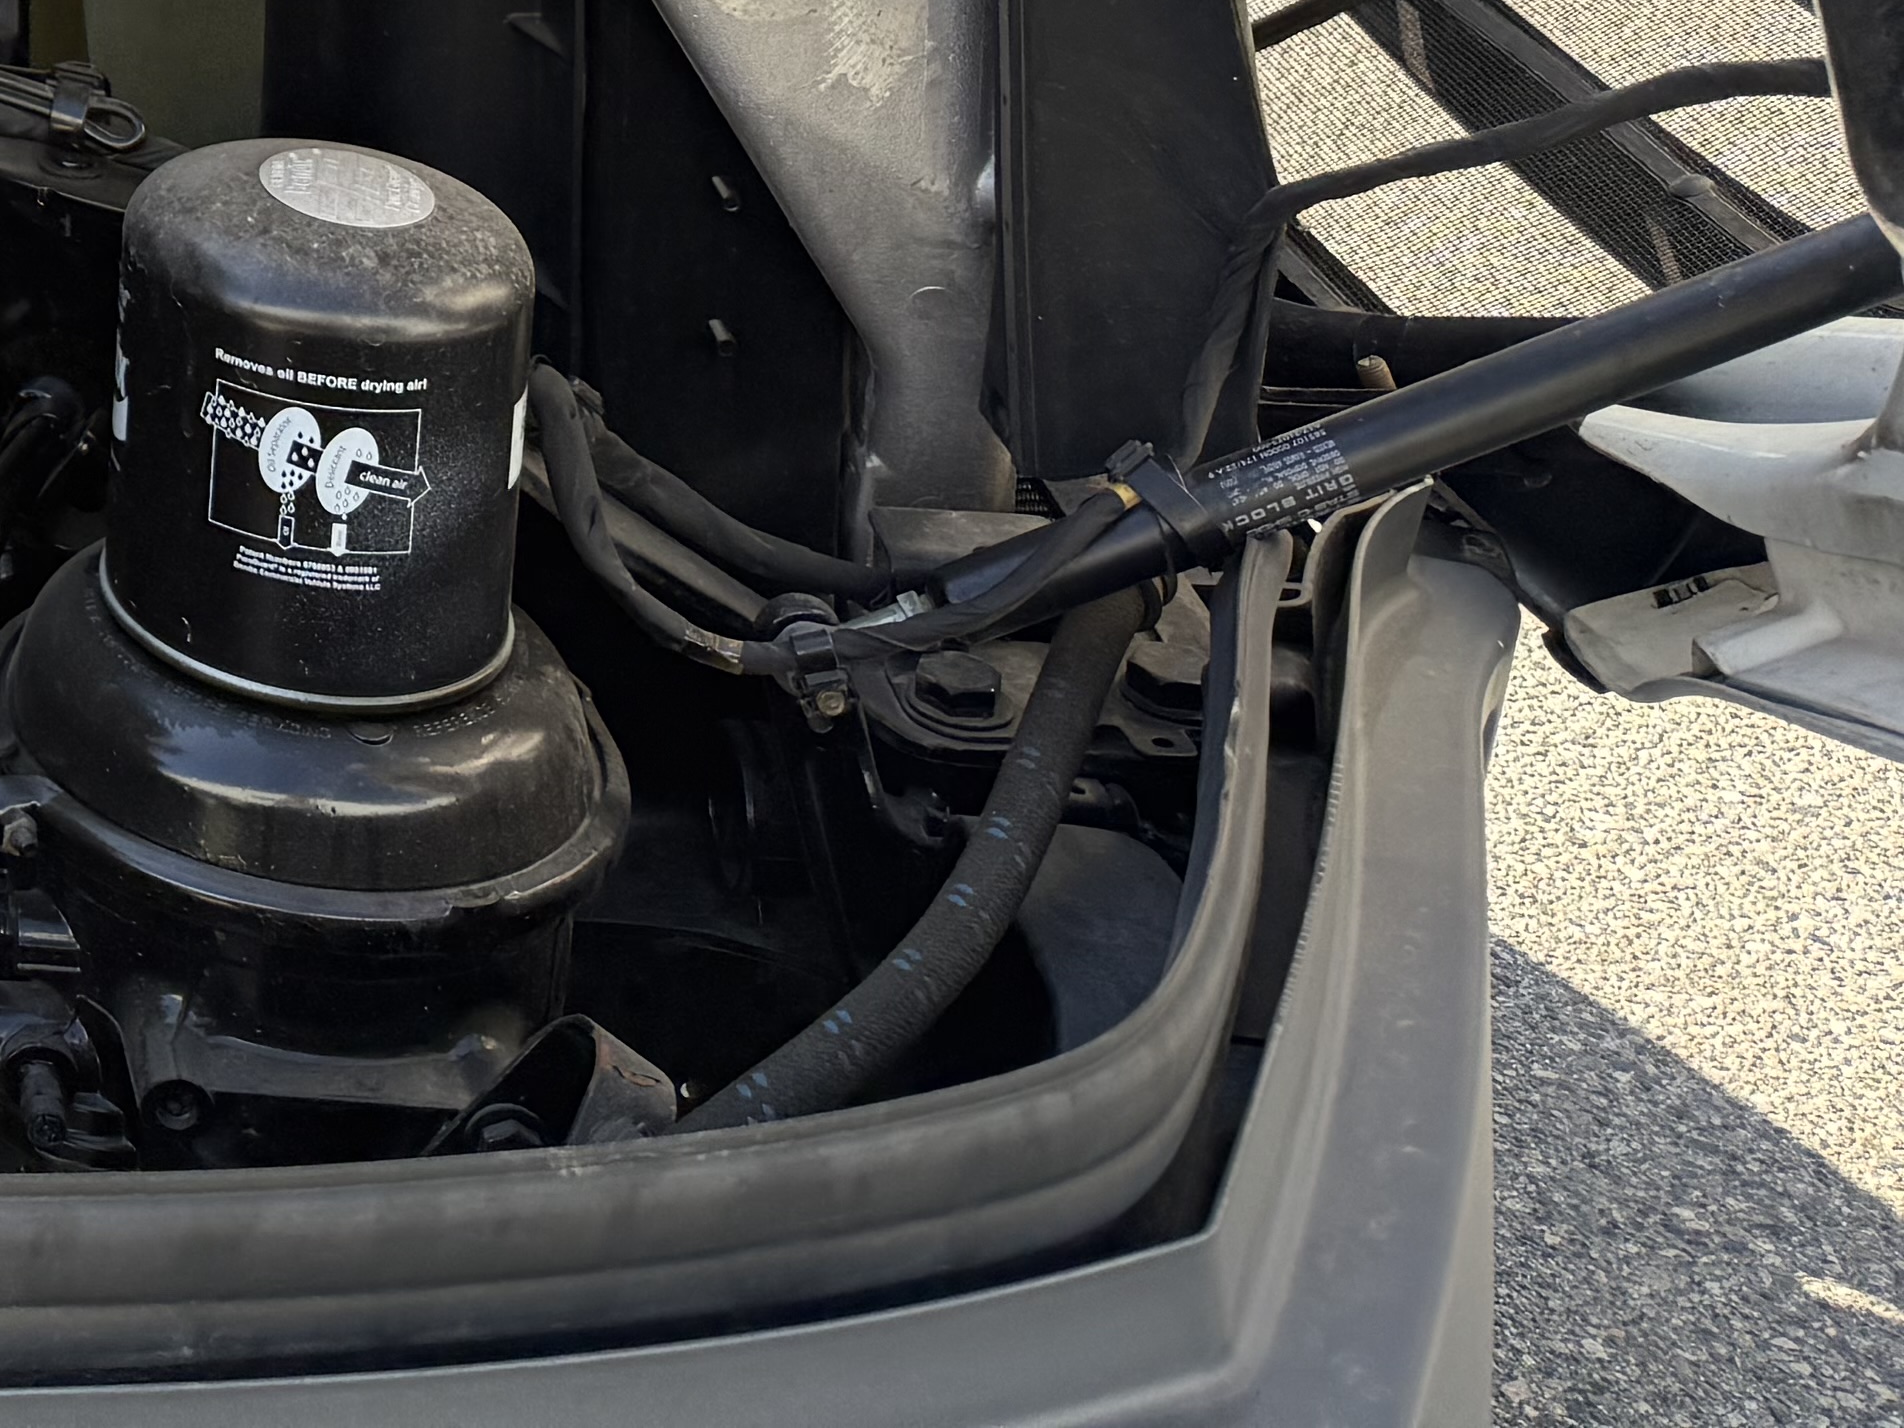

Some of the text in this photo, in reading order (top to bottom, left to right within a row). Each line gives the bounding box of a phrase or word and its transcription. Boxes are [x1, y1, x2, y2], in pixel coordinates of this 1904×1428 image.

[214, 346, 274, 377] Removes
[276, 367, 297, 383] oil
[297, 370, 359, 392] BEFORE
[360, 378, 405, 395] drying
[359, 470, 409, 492] clean air
[1220, 494, 1296, 532] BLOCK
